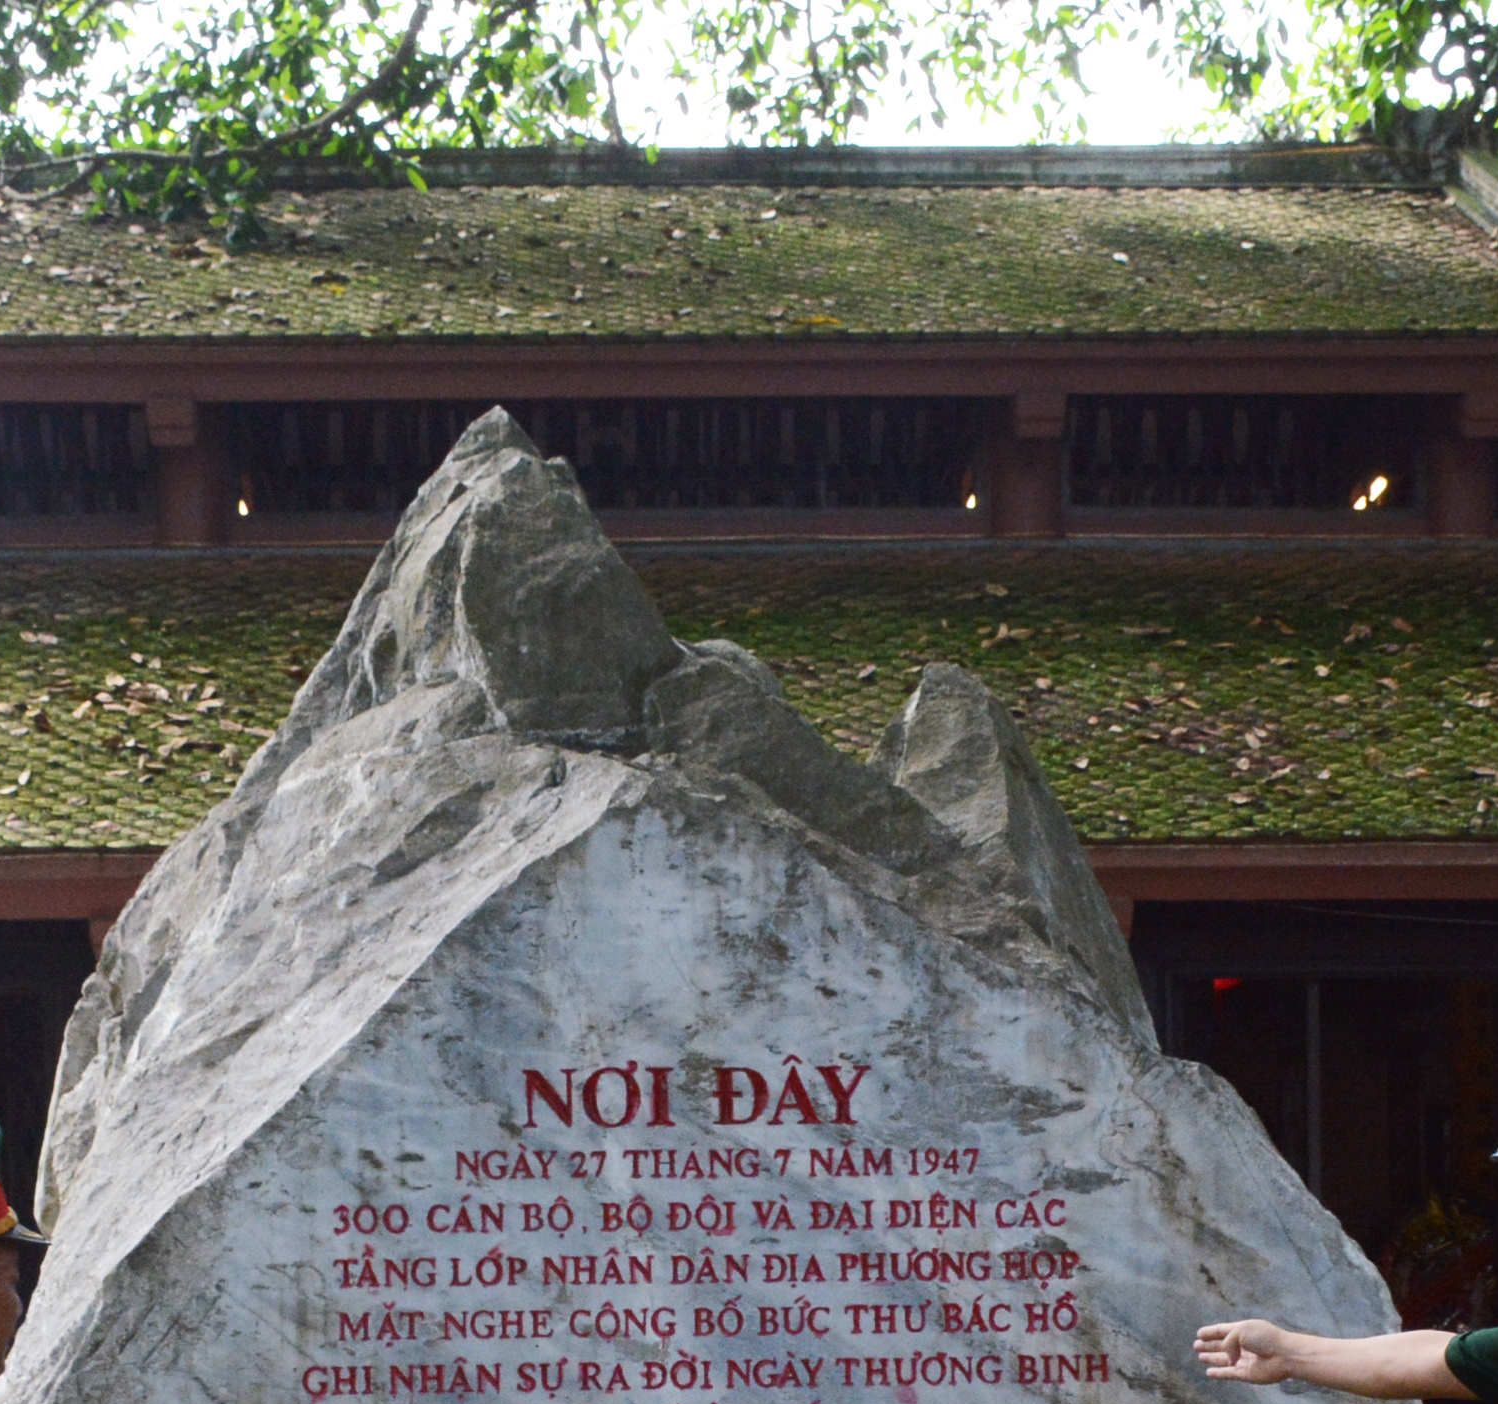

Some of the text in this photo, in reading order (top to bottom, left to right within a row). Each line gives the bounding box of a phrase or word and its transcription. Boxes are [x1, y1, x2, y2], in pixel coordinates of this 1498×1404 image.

[523, 1055, 871, 1128] NƠI ĐÂY
[456, 1144, 557, 1180] NGÀY
[571, 1151, 606, 1178] 27
[774, 1149, 792, 1176] 7
[810, 1141, 893, 1178] NĂM
[909, 1148, 980, 1176] 1947
[333, 1204, 409, 1236] 300
[427, 1195, 505, 1234] CÁN
[601, 1195, 653, 1237] BỘ
[667, 1195, 736, 1237] ĐỘI
[754, 1194, 796, 1230] VÀ
[809, 1200, 874, 1235] ĐẠI
[889, 1191, 978, 1235] DIỆN
[996, 1191, 1067, 1228] CÁC
[450, 1245, 528, 1287] LỚP
[543, 1247, 653, 1285] NHÂN
[670, 1247, 749, 1284] DÂN
[763, 1254, 826, 1288] ĐỊA
[838, 1247, 992, 1283] PHƯƠNG
[1004, 1250, 1079, 1293] HỌP
[339, 1288, 1078, 1347] MẶT NGHE CÔNG BỐ BỨC THƯ BÁC HỒ
[303, 1349, 1110, 1400] GHI NHẬN SỰ RA ĐỜI NGÀY THƯƠNG BINH
